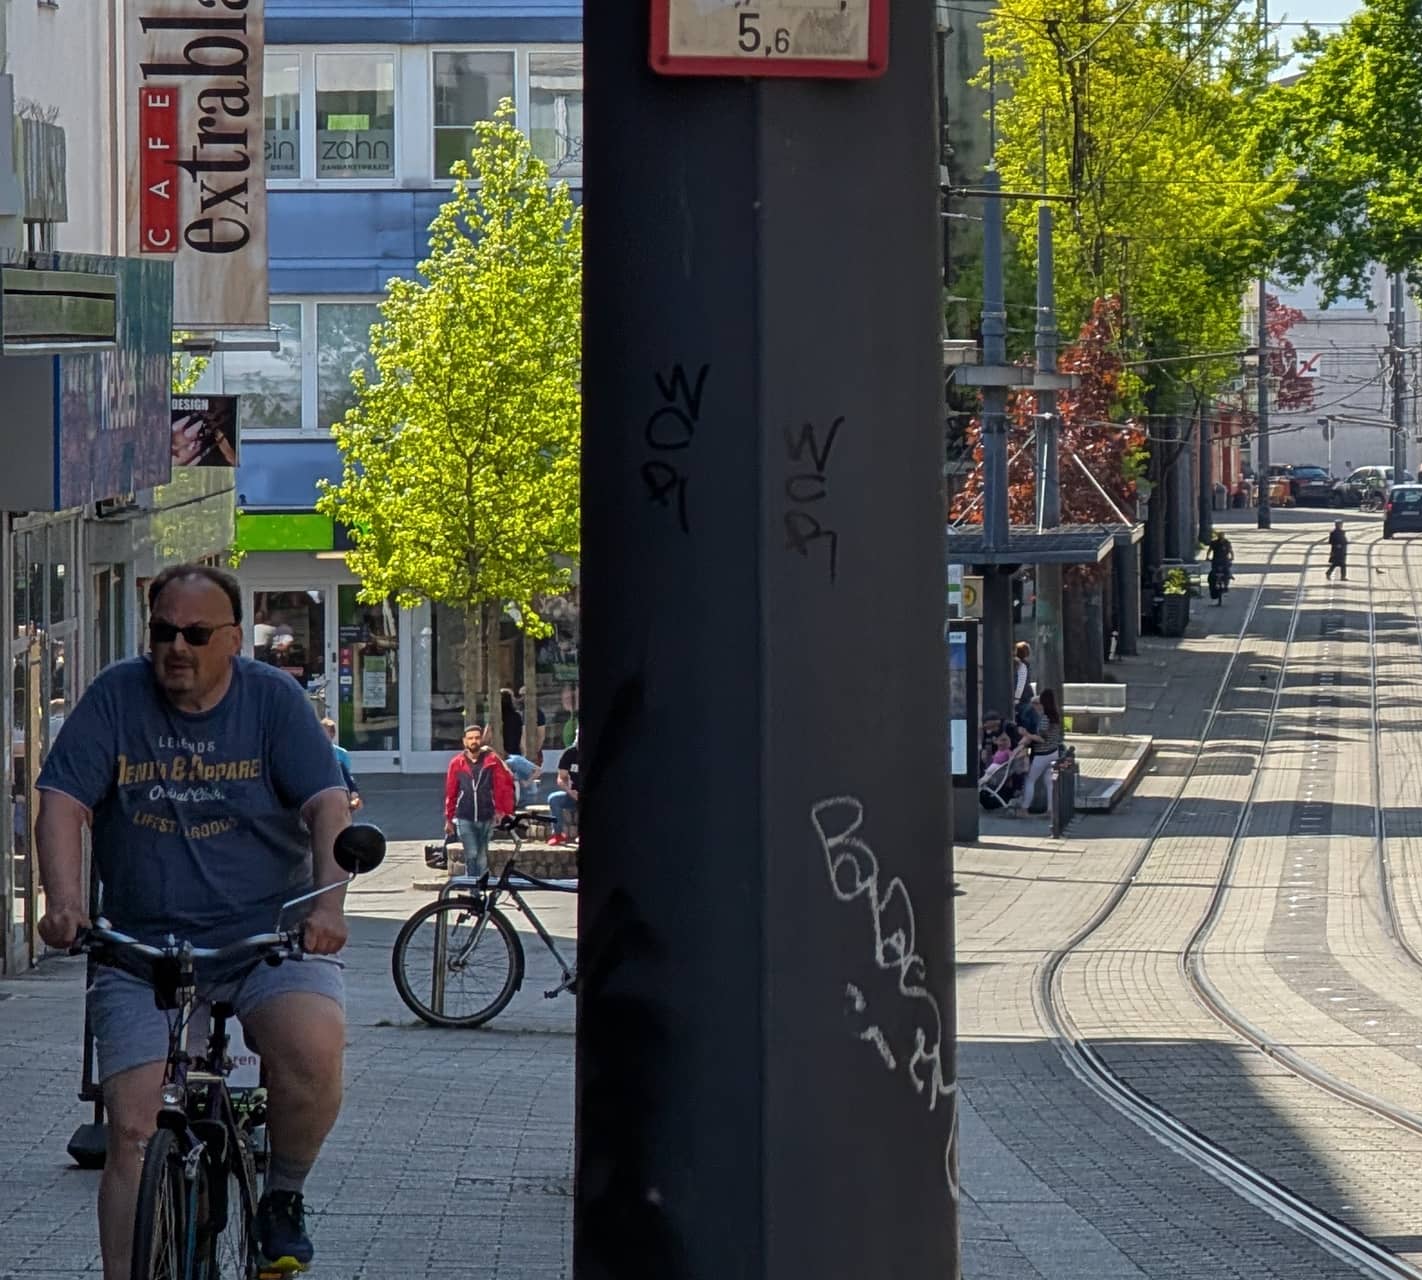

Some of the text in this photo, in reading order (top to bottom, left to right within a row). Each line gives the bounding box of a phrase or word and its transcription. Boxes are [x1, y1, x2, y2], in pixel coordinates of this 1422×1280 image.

[322, 133, 389, 160] zahn
[149, 95, 170, 246] CAFE
[172, 399, 208, 410] DESIGN
